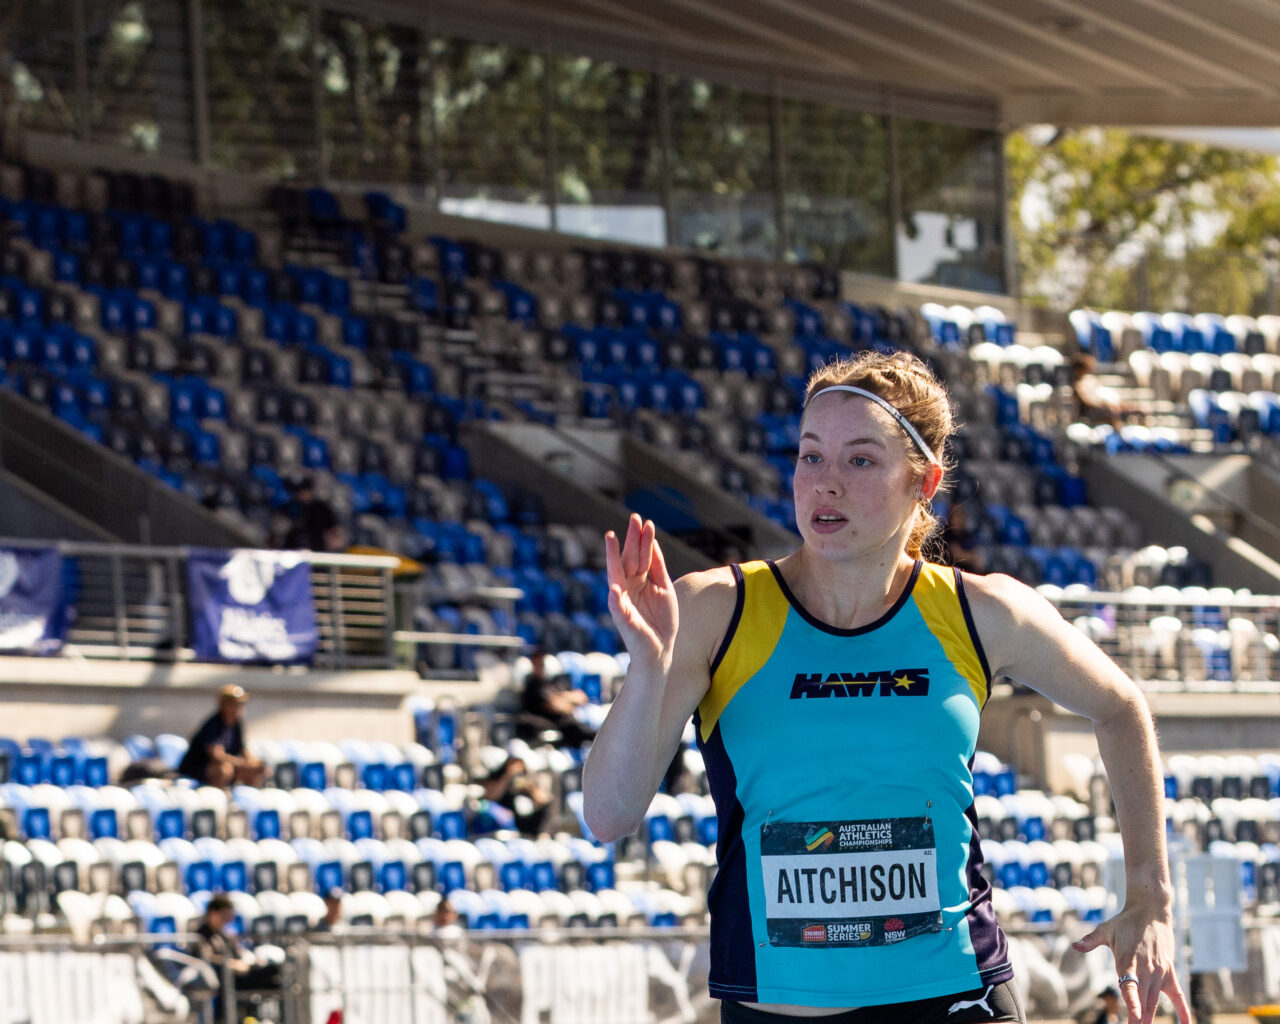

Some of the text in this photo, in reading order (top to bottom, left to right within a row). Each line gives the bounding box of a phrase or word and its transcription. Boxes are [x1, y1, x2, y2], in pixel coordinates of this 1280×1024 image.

[790, 668, 930, 699] HAWKS
[839, 822, 892, 833] AUSTRALIAN
[839, 830, 892, 841] ATHLETICS
[839, 838, 893, 847] CHAMPIONSHIPS
[777, 862, 927, 904] AITCHISON
[827, 923, 872, 934] SUMMER
[884, 930, 906, 941] NSW
[828, 932, 860, 942] SERIES
